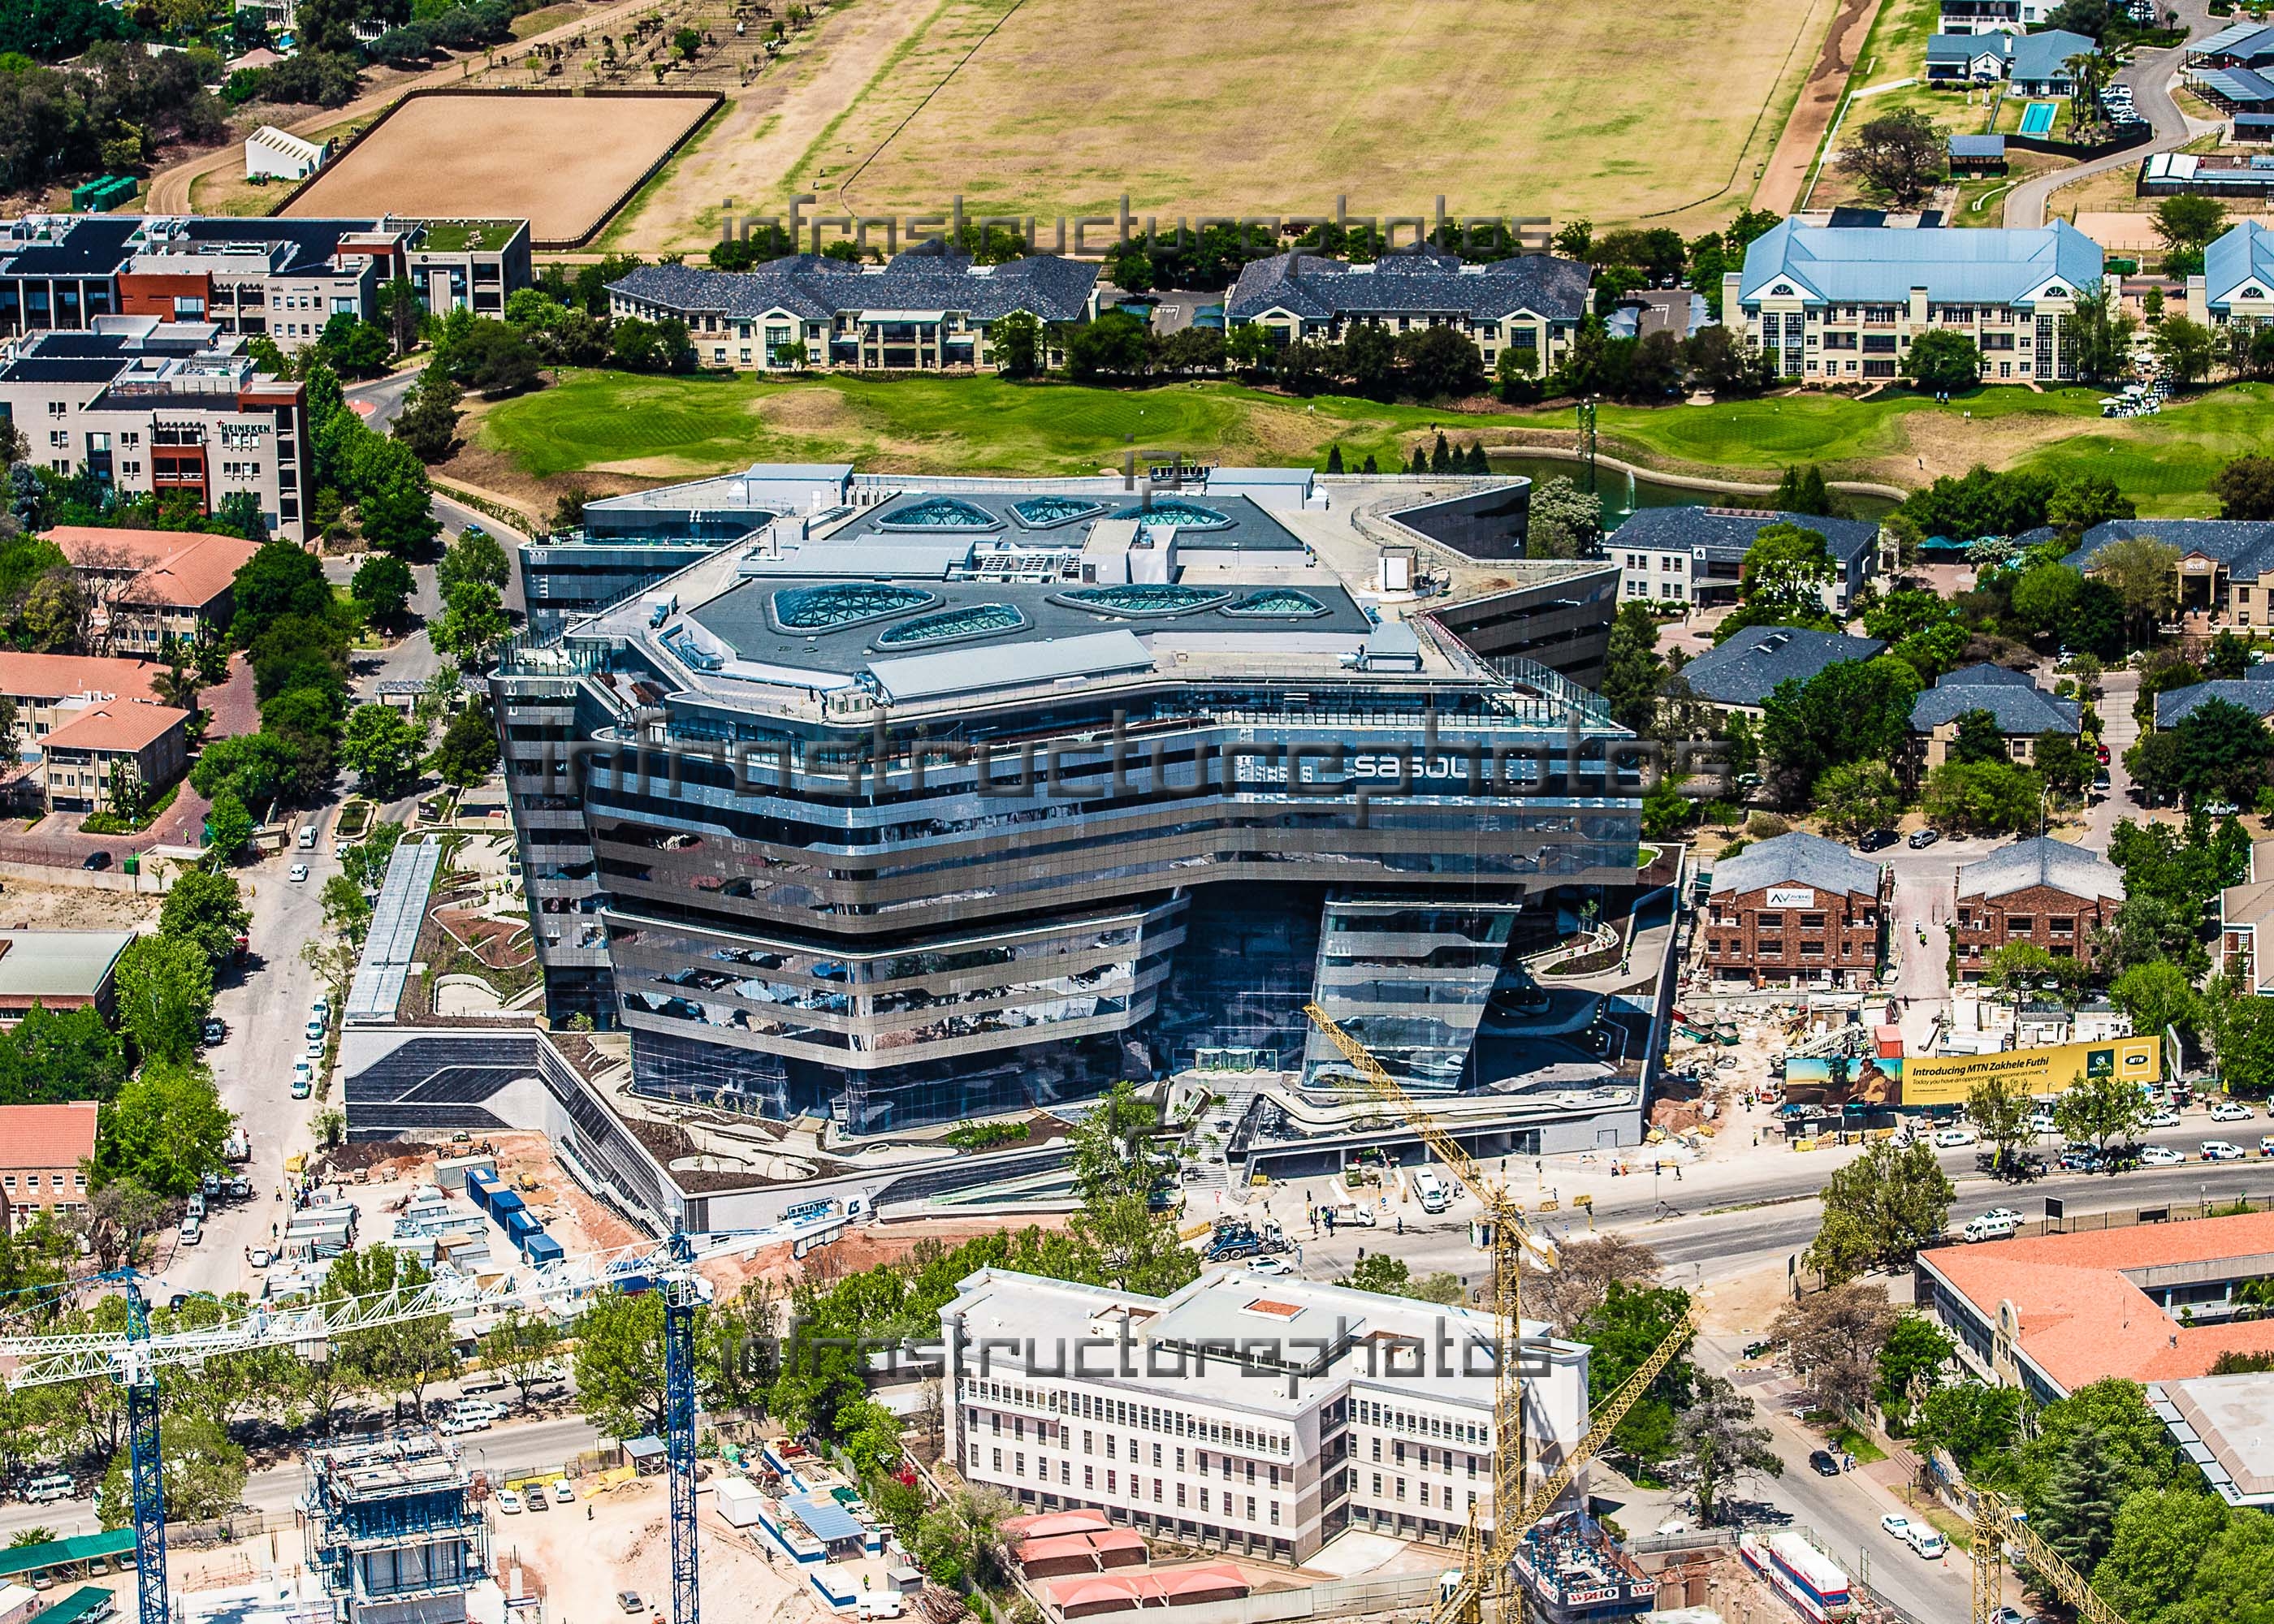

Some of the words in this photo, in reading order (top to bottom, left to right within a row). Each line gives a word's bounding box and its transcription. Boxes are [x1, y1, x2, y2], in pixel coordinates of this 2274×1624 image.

[221, 424, 270, 434] HEINEKEN
[1913, 1065, 1966, 1076] Introducing
[1967, 1063, 1988, 1073] MTN
[1989, 1059, 2025, 1071] Zakhele
[2025, 1056, 2050, 1067] Futhi
